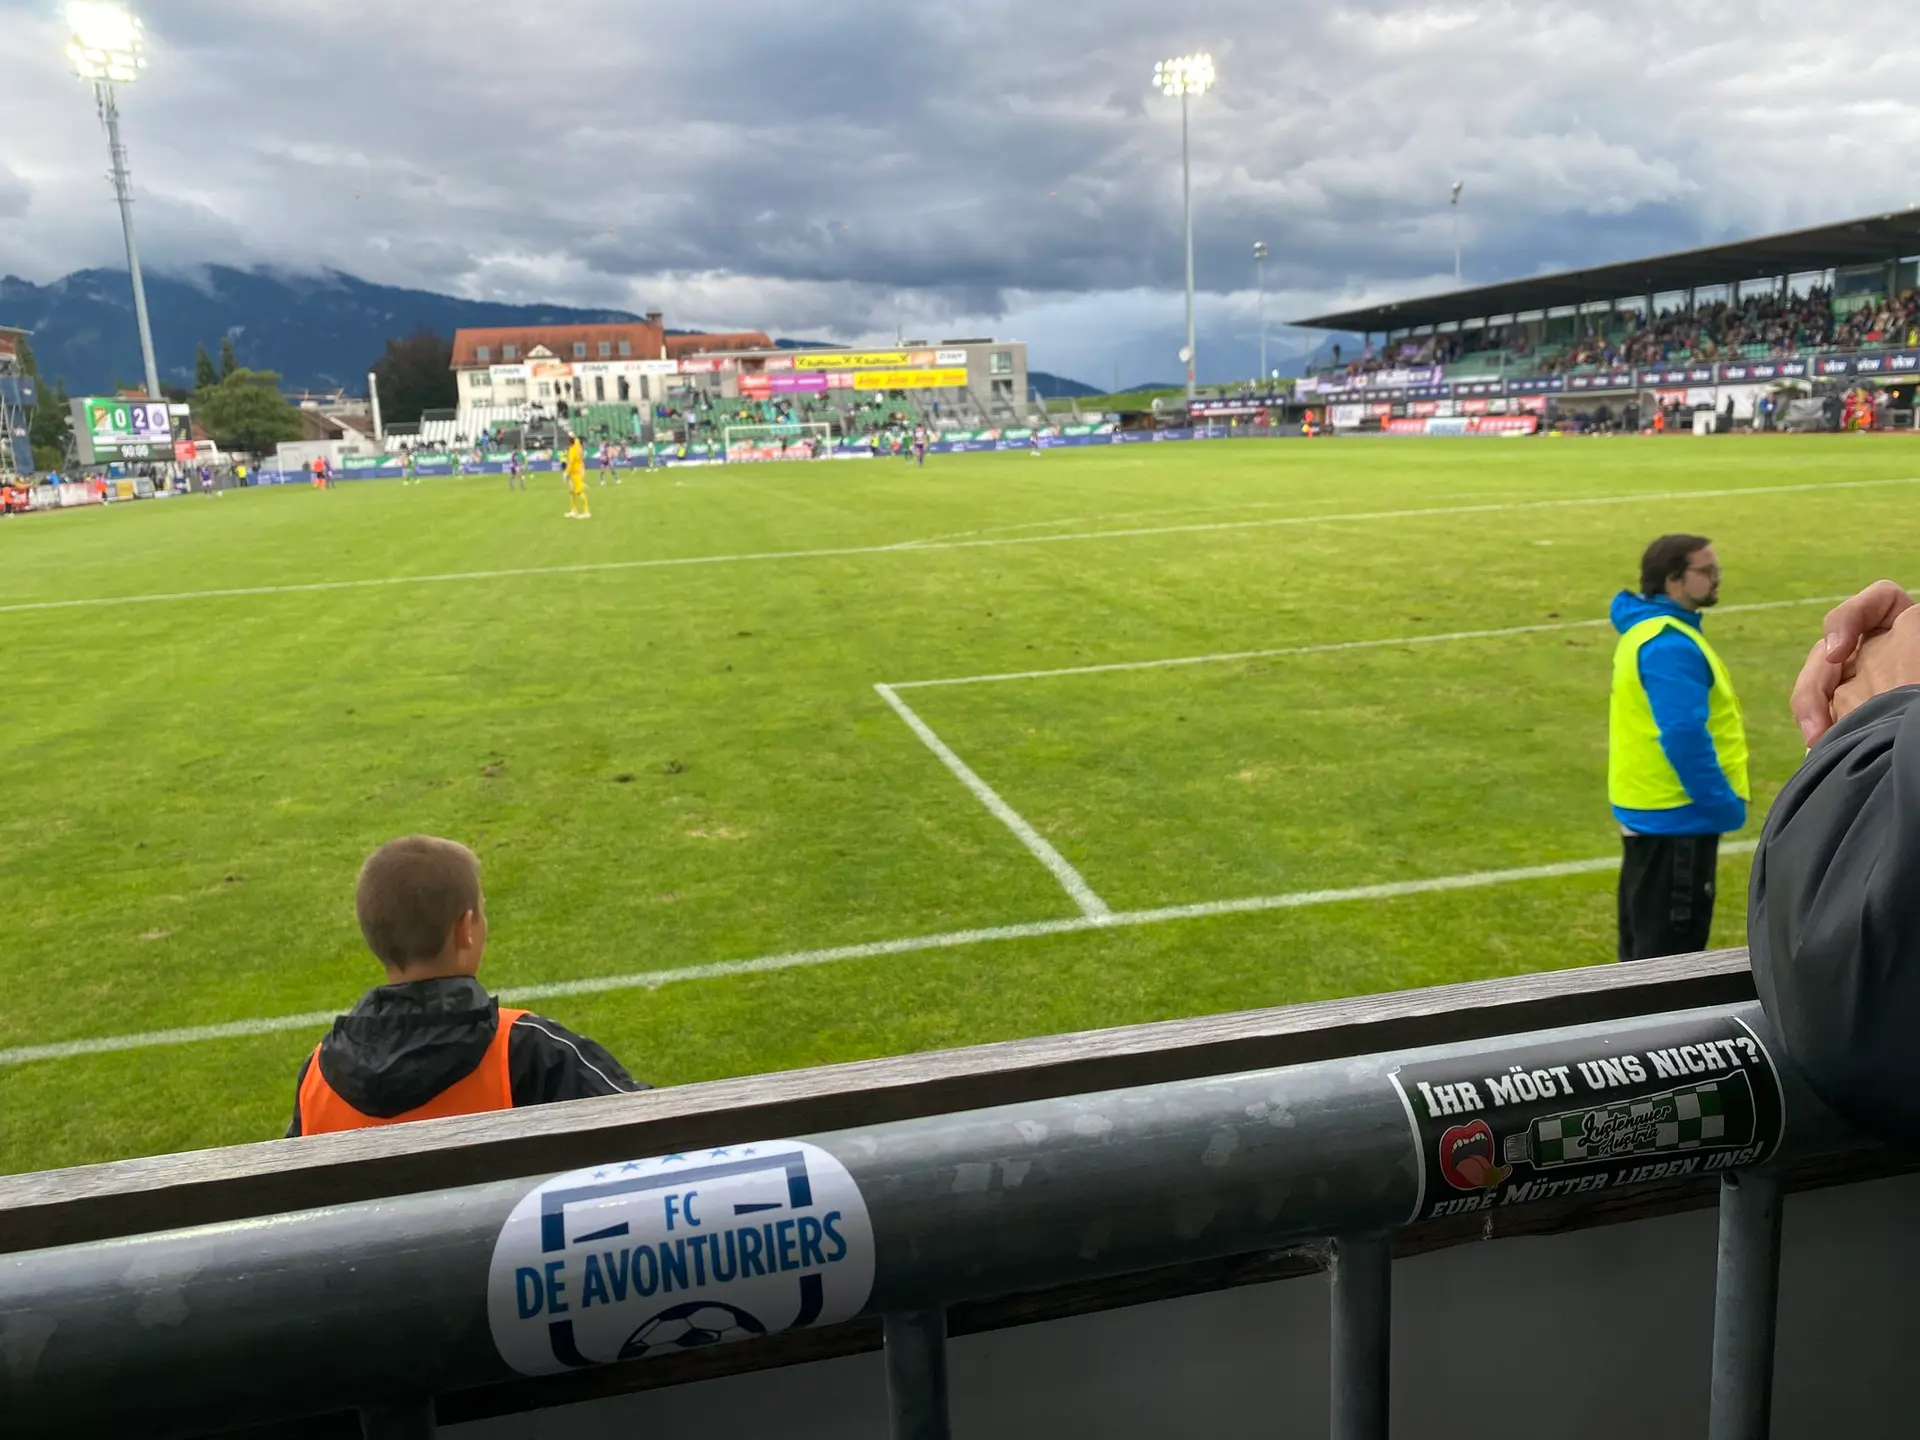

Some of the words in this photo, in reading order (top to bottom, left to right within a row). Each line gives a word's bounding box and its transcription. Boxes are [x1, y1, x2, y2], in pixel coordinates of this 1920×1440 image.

[114, 408, 127, 428] 0
[133, 408, 146, 427] 2
[1485, 1066, 1574, 1108] MÖGT
[1577, 1055, 1647, 1091] UNS
[1647, 1037, 1760, 1078] NICHT?
[1577, 1104, 1672, 1148] Lustenauer
[1599, 1124, 1660, 1157] Austria
[1428, 1192, 1497, 1219] EURE
[1500, 1173, 1608, 1206] MÜTTER
[1612, 1157, 1700, 1187] LIEBEN
[1704, 1141, 1764, 1170] UNS!
[664, 1191, 701, 1231] FC
[515, 1260, 569, 1320] DE
[581, 1211, 847, 1308] AVONTURIERS
